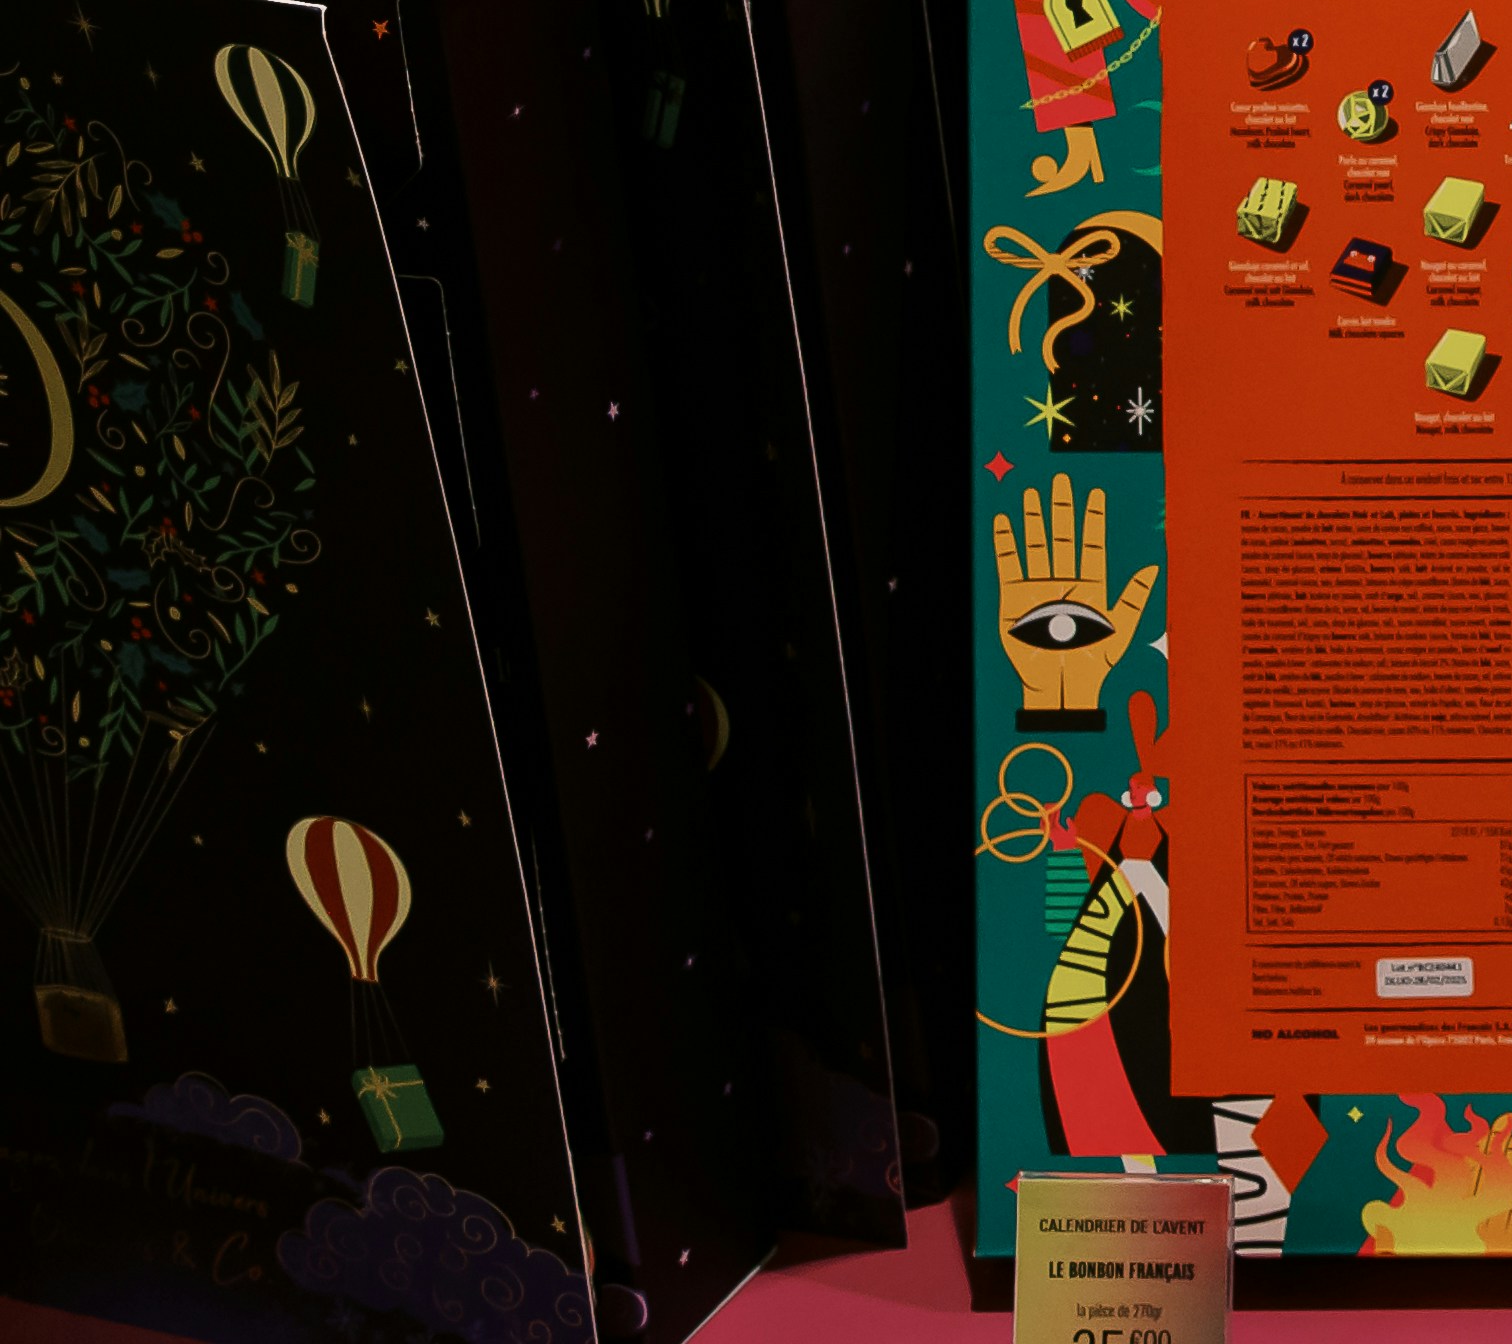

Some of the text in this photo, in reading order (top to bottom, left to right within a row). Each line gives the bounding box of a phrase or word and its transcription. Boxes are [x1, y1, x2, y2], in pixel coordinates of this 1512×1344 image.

[1252, 1029, 1340, 1041] NO ALCOHOL
[1039, 1218, 1126, 1234] CALENDRIER
[1131, 1219, 1148, 1234] DE
[1049, 1261, 1195, 1283] LE BONBON FRANÇAIS
